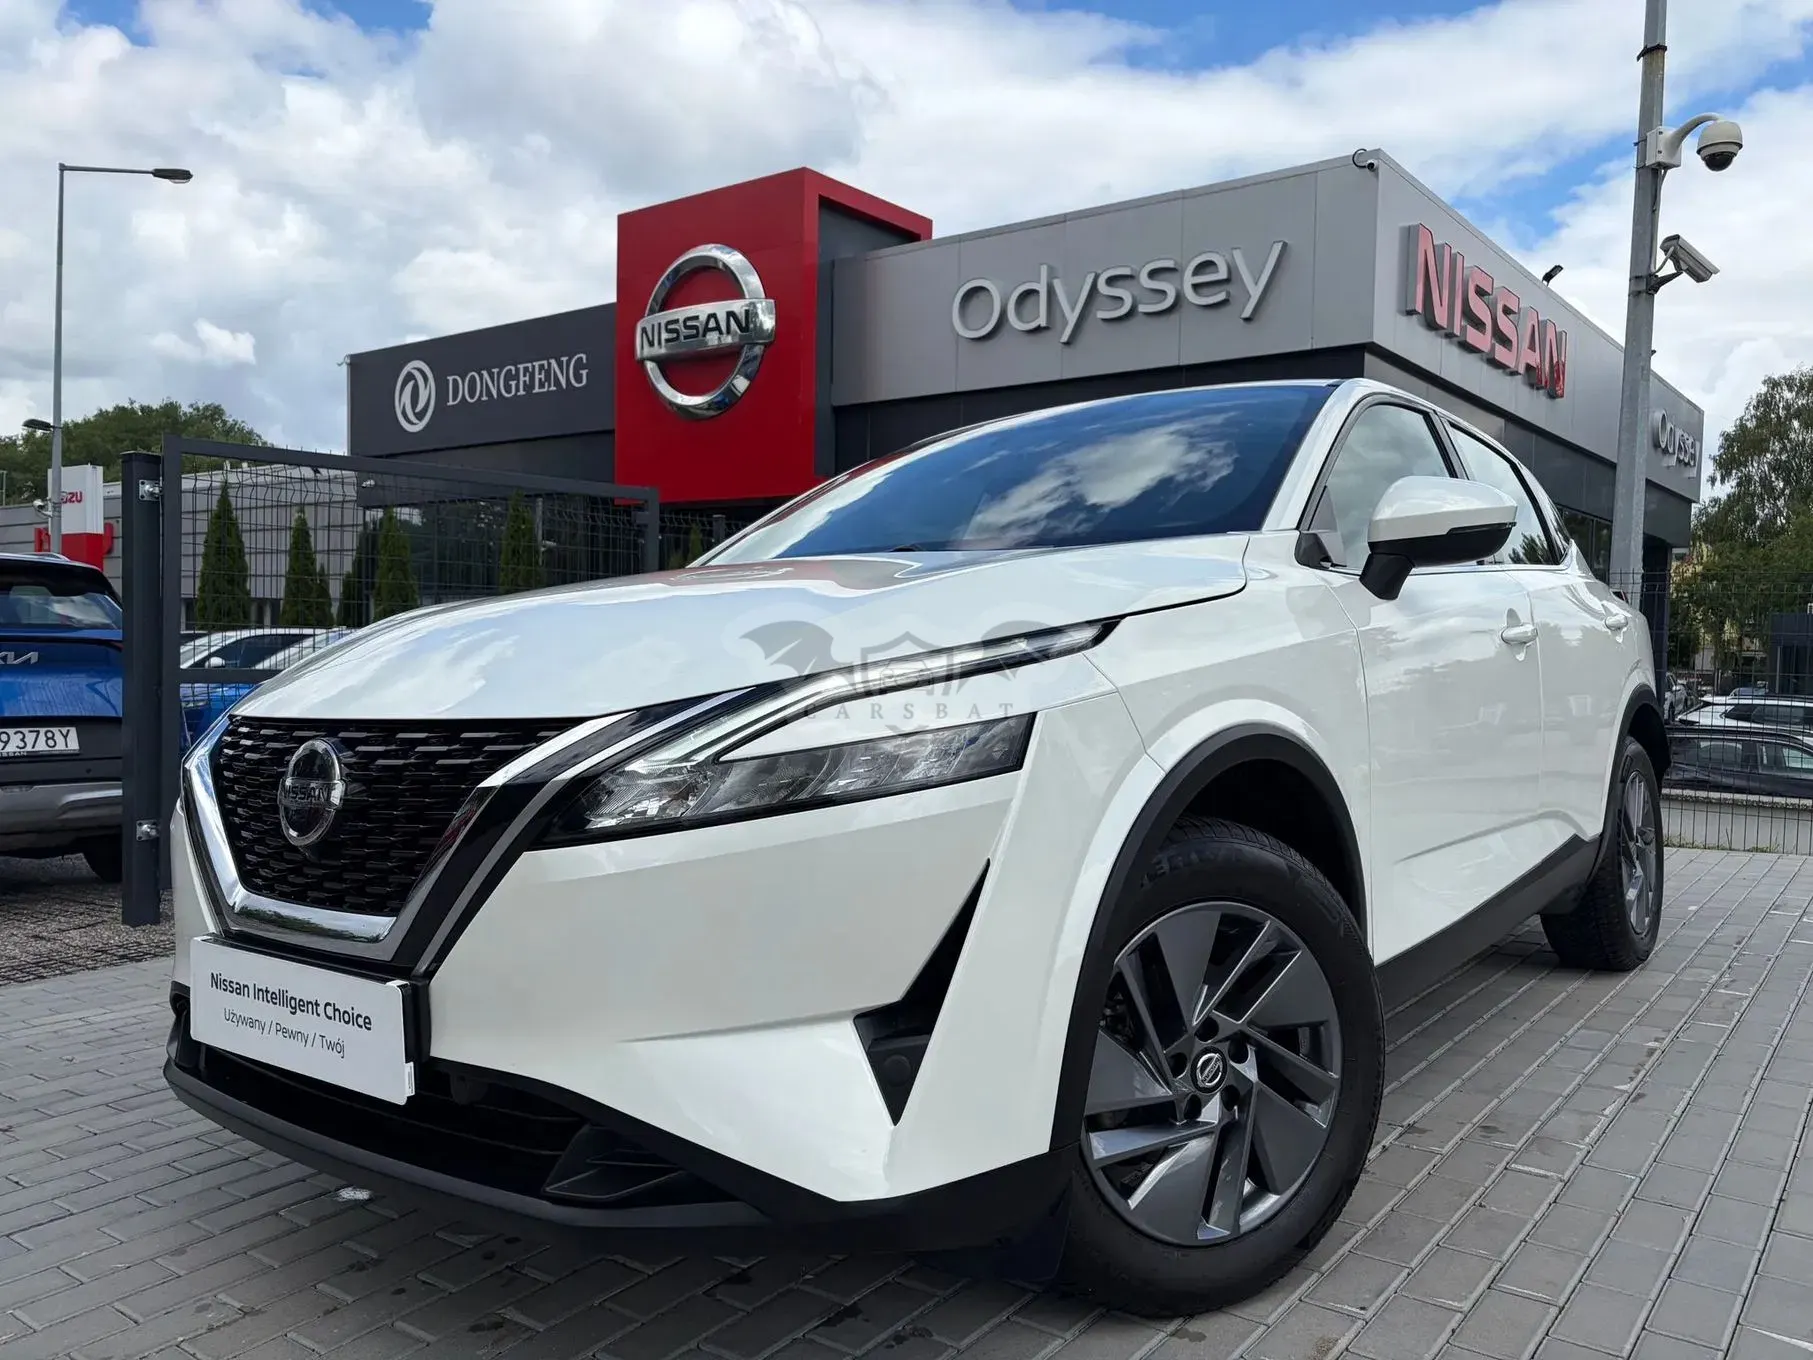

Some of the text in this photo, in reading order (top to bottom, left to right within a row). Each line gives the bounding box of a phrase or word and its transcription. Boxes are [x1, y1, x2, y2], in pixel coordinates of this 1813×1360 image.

[952, 240, 1288, 344] Odyssey
[1409, 222, 1568, 398] NISSAN
[640, 308, 750, 350] NISSAN
[446, 353, 589, 406] DONGFENG
[0, 729, 71, 751] 9378Y
[210, 972, 372, 1031] Nissan Intelligent Choice
[223, 1008, 267, 1035] Używany
[275, 1022, 310, 1048] Pewny
[319, 1034, 346, 1059] Twój
